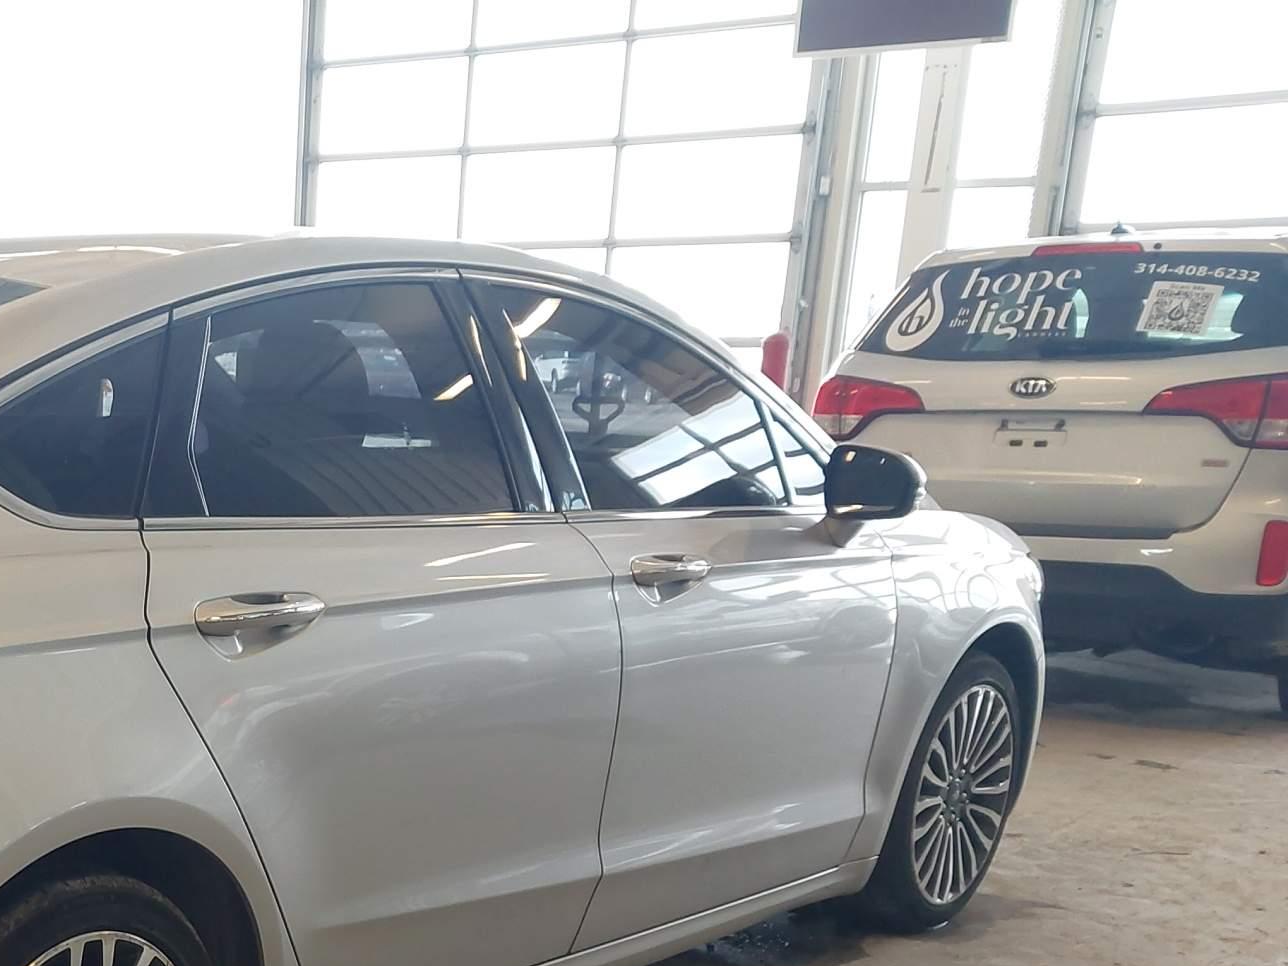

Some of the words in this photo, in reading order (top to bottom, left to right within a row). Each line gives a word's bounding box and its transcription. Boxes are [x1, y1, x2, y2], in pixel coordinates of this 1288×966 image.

[960, 267, 1083, 305] hope
[1134, 263, 1261, 282] 314-408-6232
[966, 295, 1074, 341] light
[1015, 380, 1047, 393] KIA
